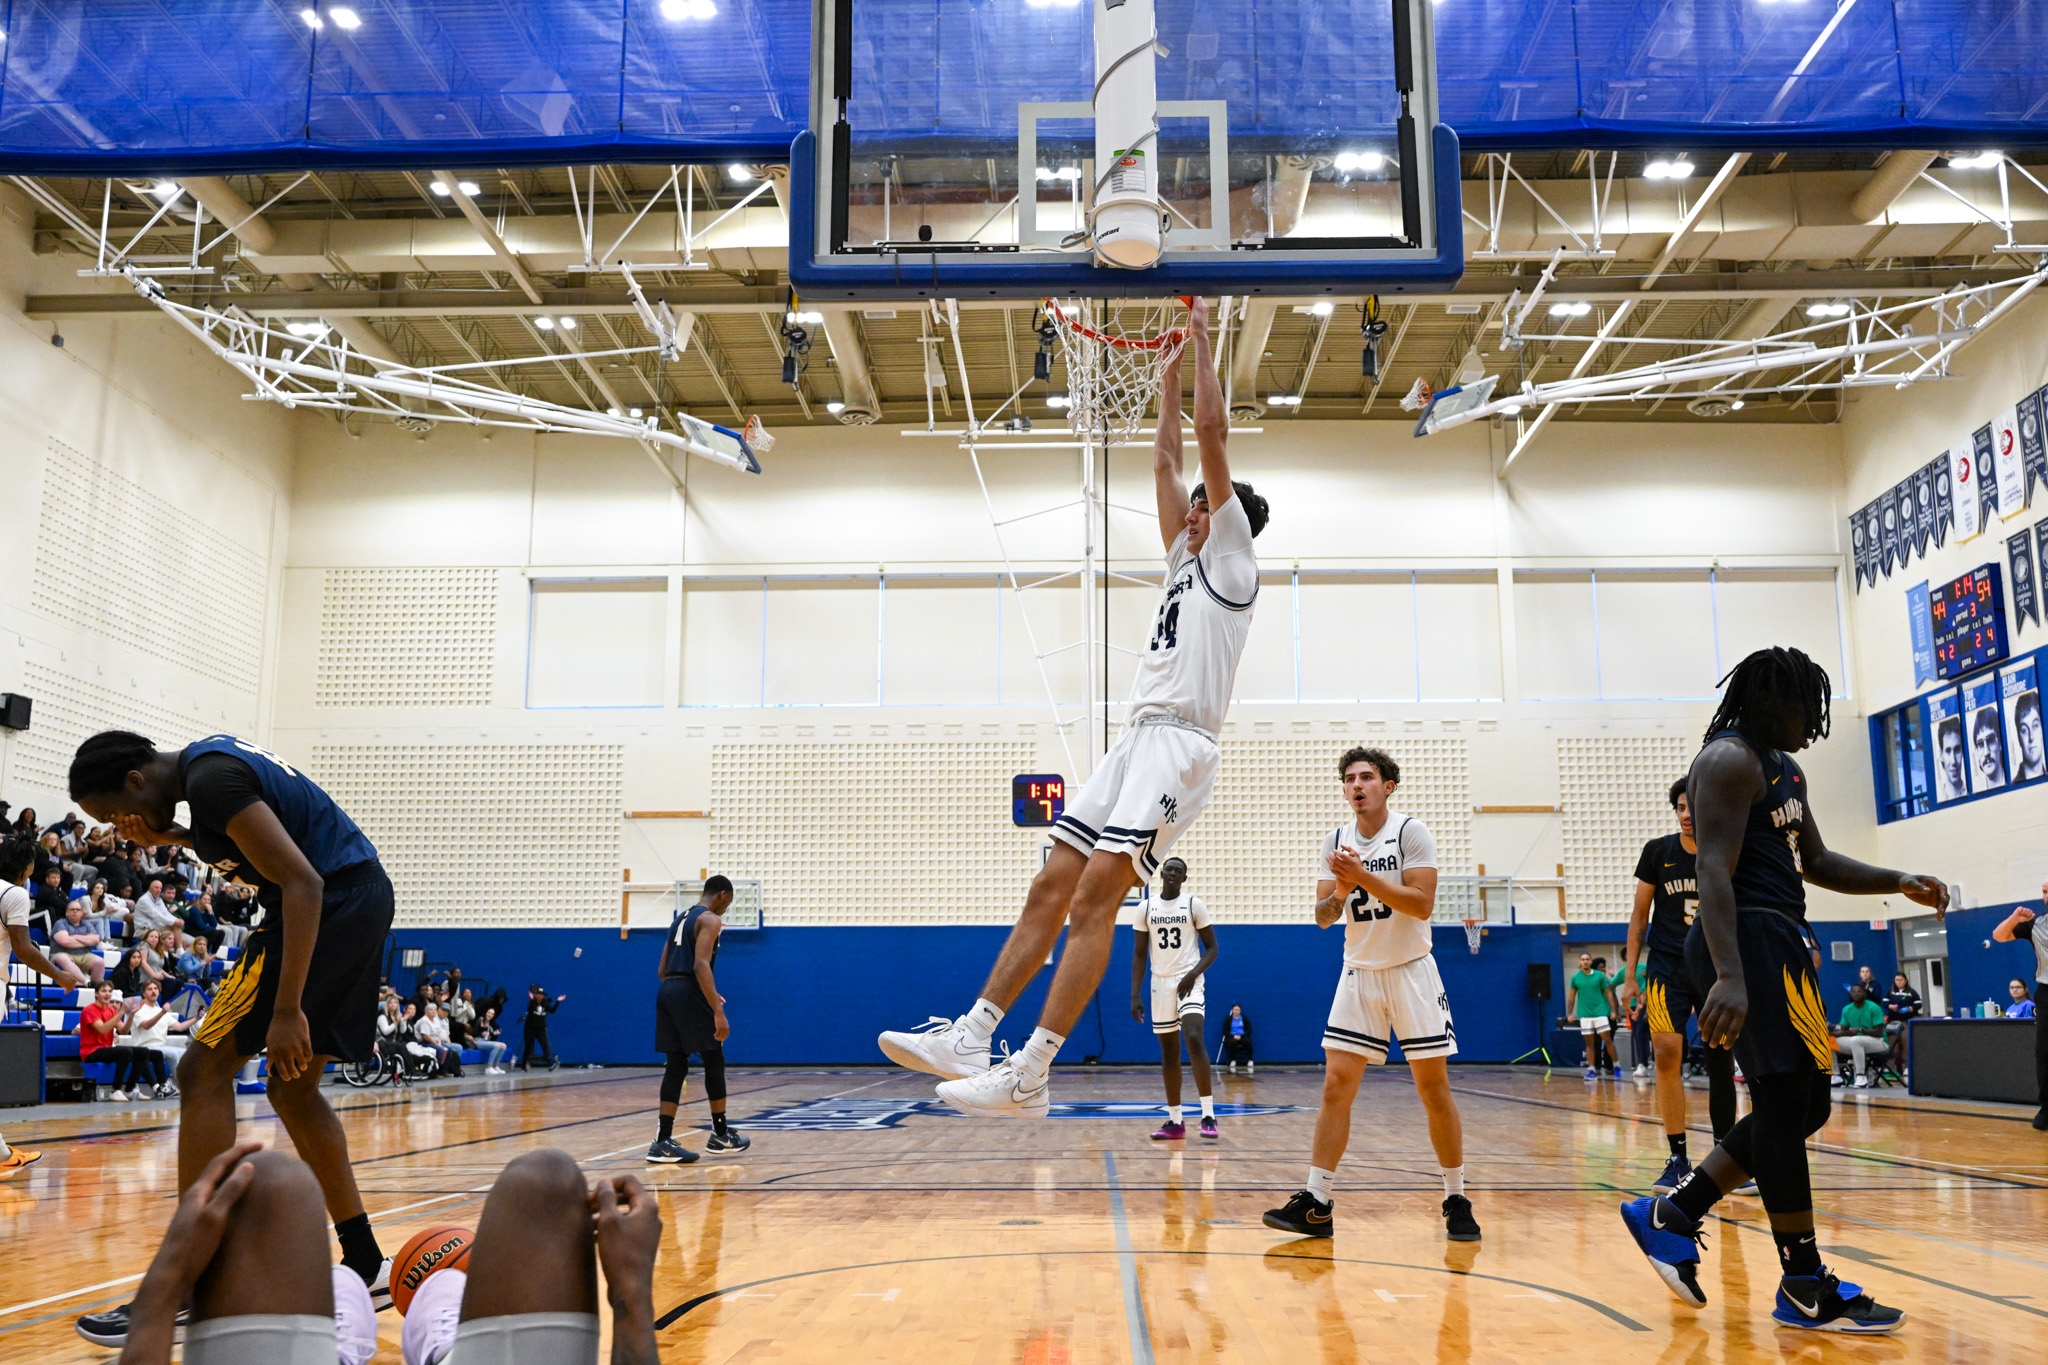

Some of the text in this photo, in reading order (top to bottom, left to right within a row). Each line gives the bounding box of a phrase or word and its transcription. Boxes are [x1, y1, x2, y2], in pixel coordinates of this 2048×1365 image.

[1954, 574, 1973, 599] 1:14
[1976, 578, 1991, 602] 54
[1932, 600, 1946, 621] 44
[1970, 601, 1977, 618] 3
[1975, 632, 1982, 648] 2
[1986, 627, 1994, 641] 4
[1938, 648, 1946, 662] 4
[1948, 643, 1955, 660] 2
[2002, 672, 2017, 688] BLAIR
[1030, 782, 1063, 799] 1:14
[1039, 800, 1052, 821] 7
[1361, 854, 1398, 873] GARA
[1664, 878, 1699, 896] HUM
[1150, 915, 1187, 925] NIAGARA
[1683, 898, 1700, 926] 5
[1157, 926, 1182, 949] 33
[402, 1236, 466, 1291] Wilson
